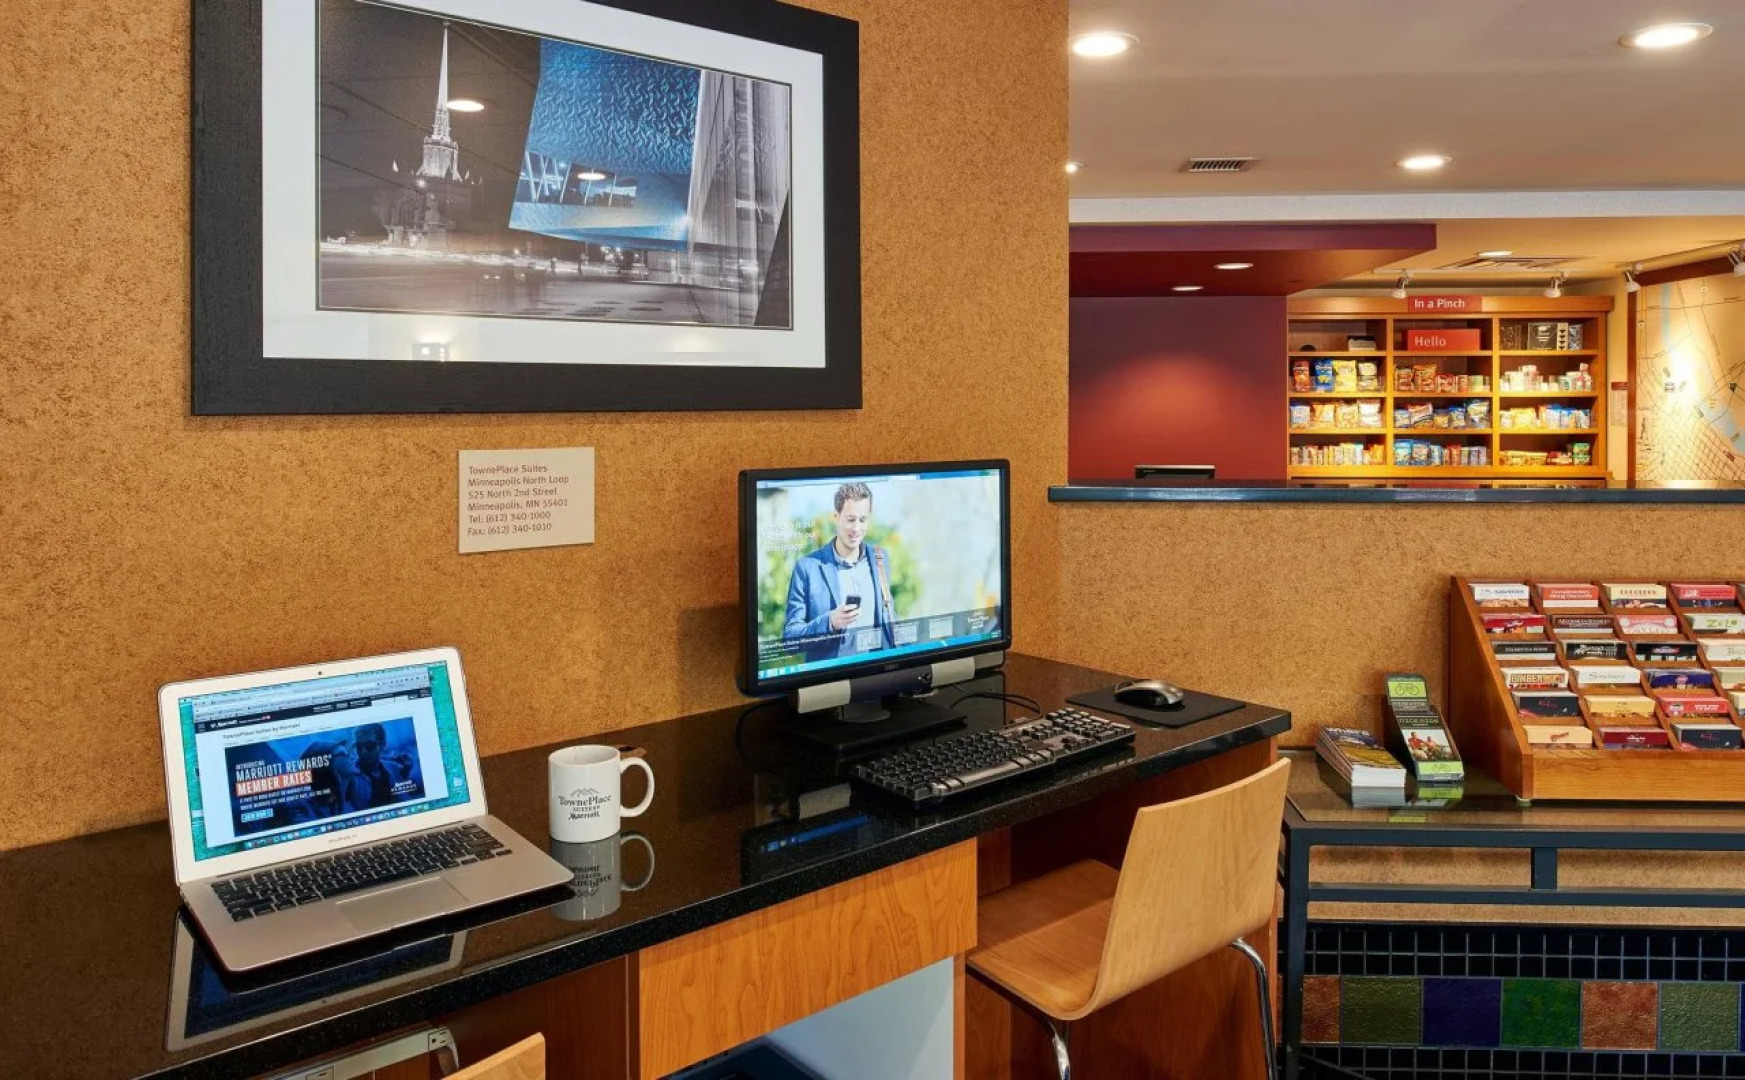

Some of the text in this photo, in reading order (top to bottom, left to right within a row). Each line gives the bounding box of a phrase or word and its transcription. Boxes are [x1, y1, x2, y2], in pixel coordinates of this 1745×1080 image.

[1414, 298, 1466, 309] In a Pinch
[1414, 336, 1446, 347] Hello
[468, 464, 548, 475] TownePlace Suites
[467, 475, 569, 487] Minneapolis North Loop
[468, 487, 558, 499] 525 North 2nd Street
[467, 499, 568, 512] Minneapolis, MN 55401
[468, 511, 551, 524] Tel: (612) 340-1000
[467, 523, 552, 536] Fax: (612) 340-1010
[236, 754, 332, 783] MARRIOTT REWARDS
[237, 776, 281, 795] MEMBER
[283, 770, 313, 787] RATES
[558, 795, 612, 806] TownePlace
[567, 811, 601, 820] Marriott
